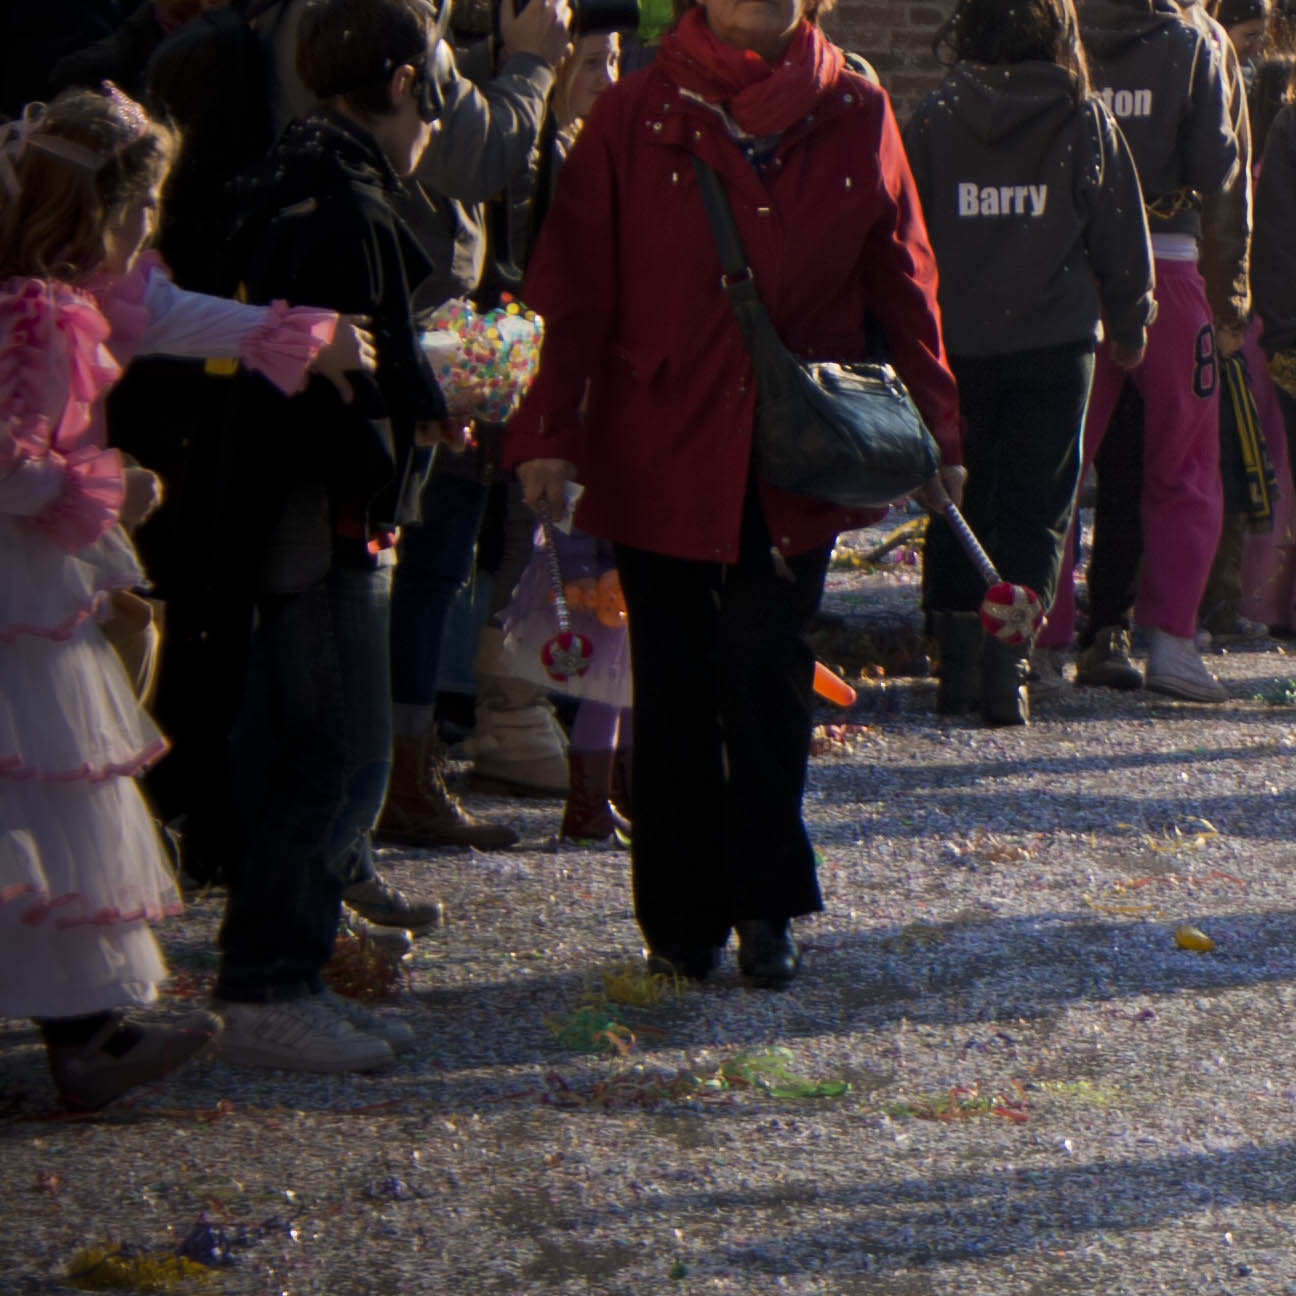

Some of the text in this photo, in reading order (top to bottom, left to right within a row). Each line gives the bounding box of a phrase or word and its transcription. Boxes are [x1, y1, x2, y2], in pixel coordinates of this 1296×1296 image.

[1094, 86, 1152, 117] ton
[958, 181, 1048, 217] Barry
[1191, 322, 1218, 399] 8
